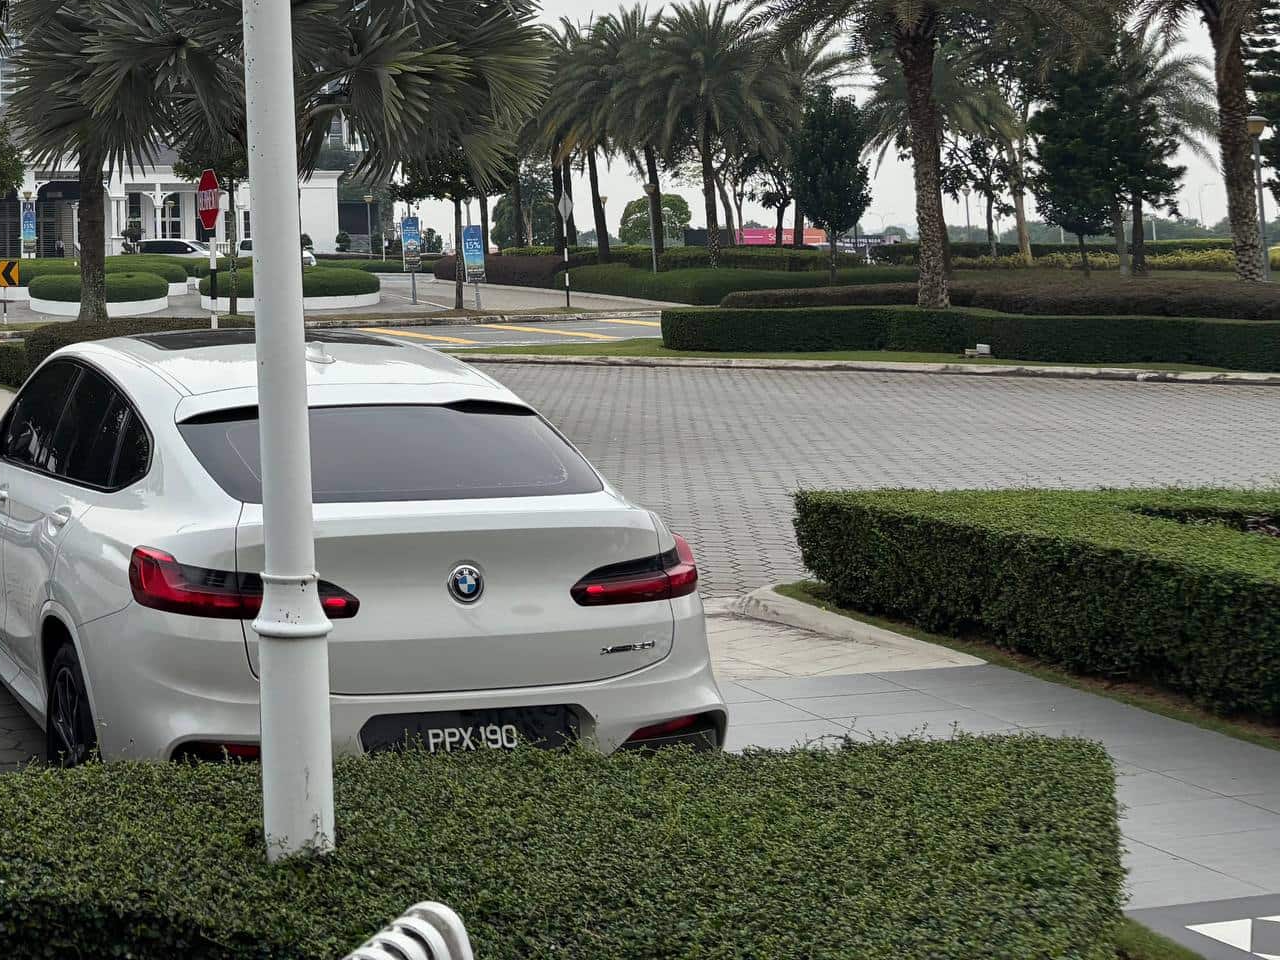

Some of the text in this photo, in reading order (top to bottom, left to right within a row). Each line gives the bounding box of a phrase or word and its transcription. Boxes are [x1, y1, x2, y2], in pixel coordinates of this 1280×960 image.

[465, 241, 481, 250] 15%
[427, 723, 518, 753] PPX 190
